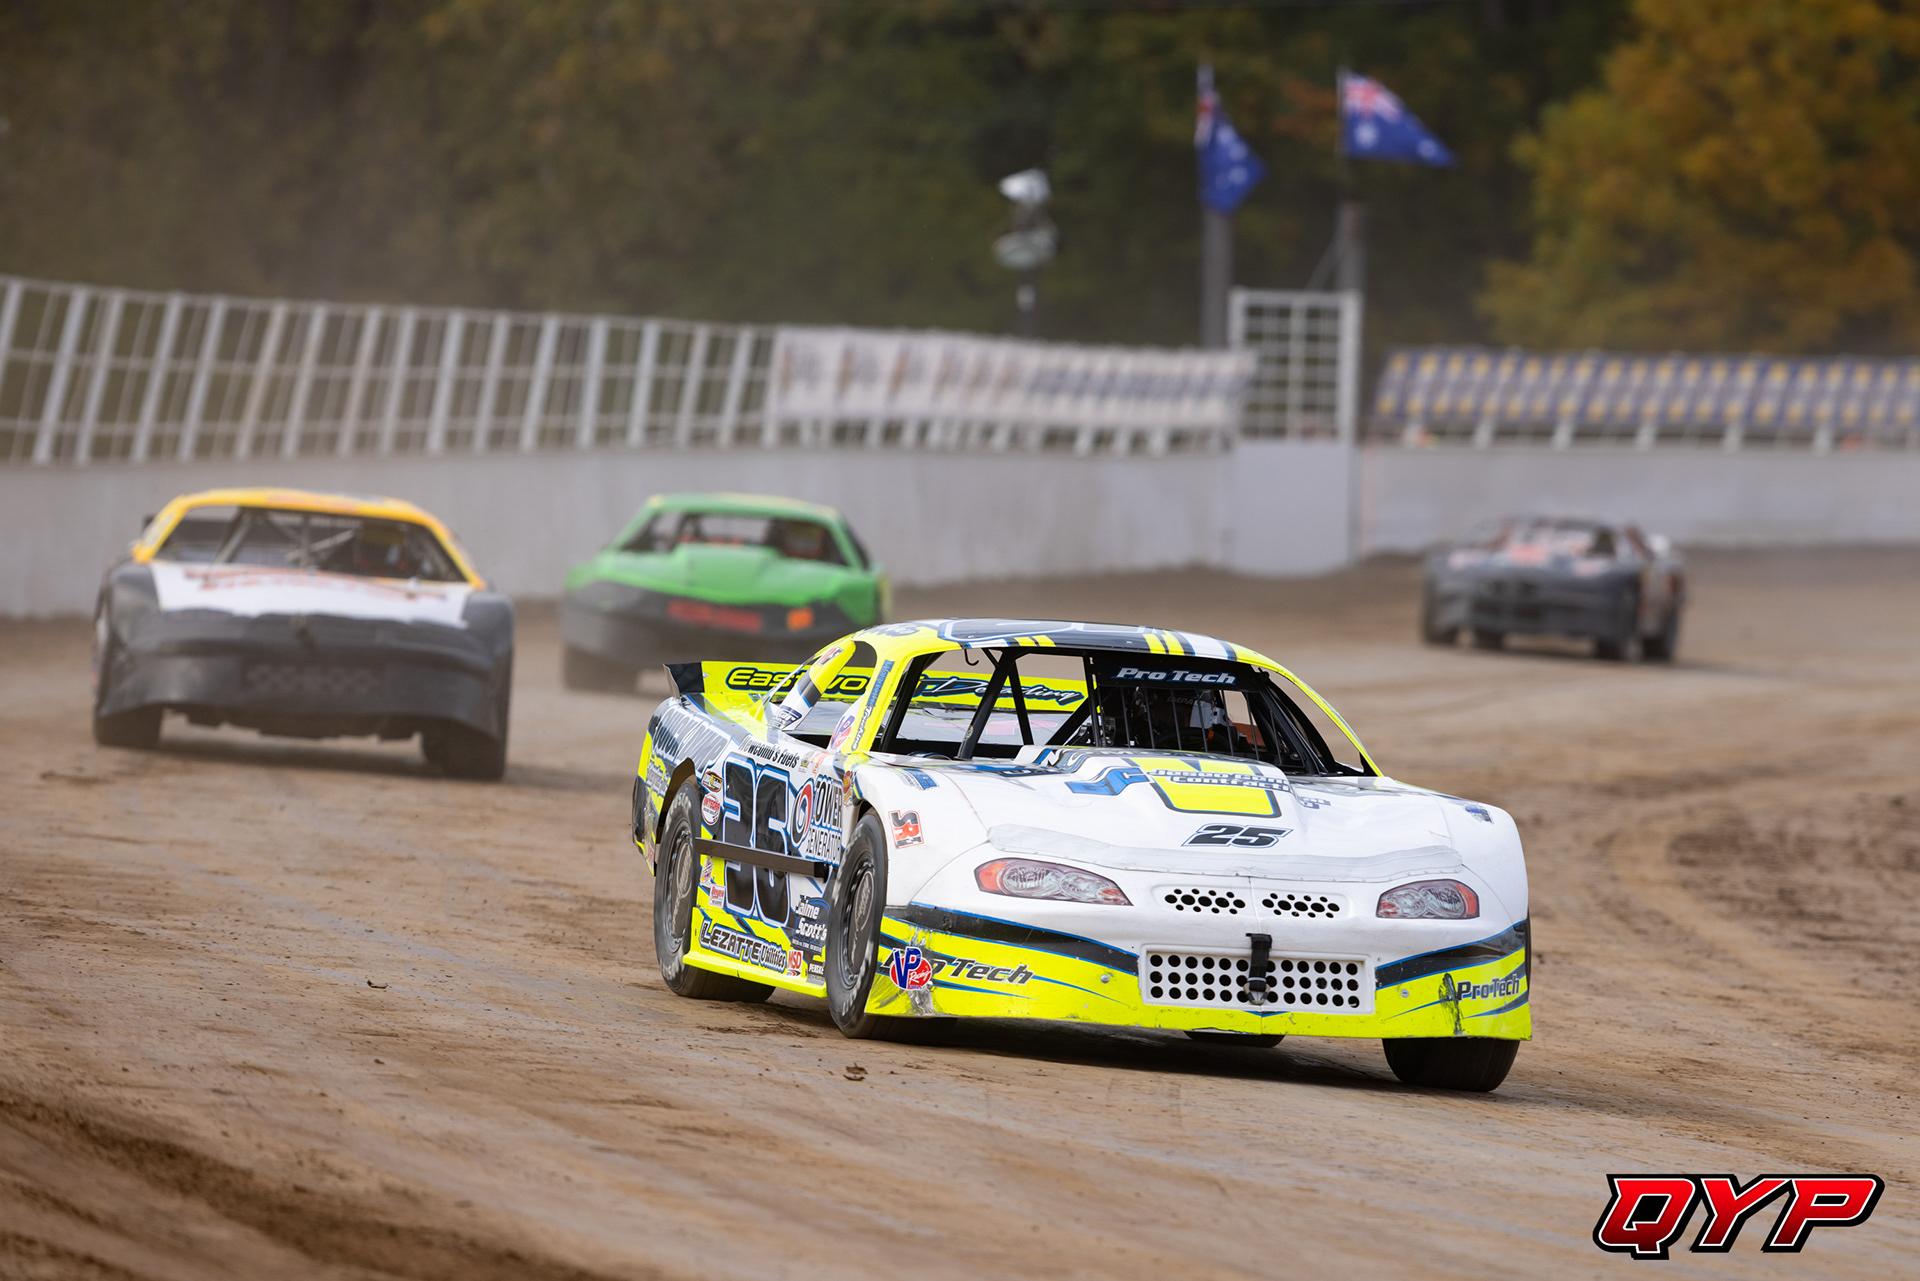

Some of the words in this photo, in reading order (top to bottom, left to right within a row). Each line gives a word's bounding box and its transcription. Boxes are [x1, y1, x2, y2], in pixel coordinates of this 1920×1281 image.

[779, 747, 800, 769] Fuels
[1182, 824, 1293, 848] 25
[795, 917, 828, 941] Scott's
[700, 920, 761, 961] LEZATTE
[761, 944, 786, 969] Utilities
[787, 949, 802, 970] MSD
[893, 946, 922, 990] VP
[949, 957, 1035, 985] Tech
[1491, 974, 1520, 999] Tech
